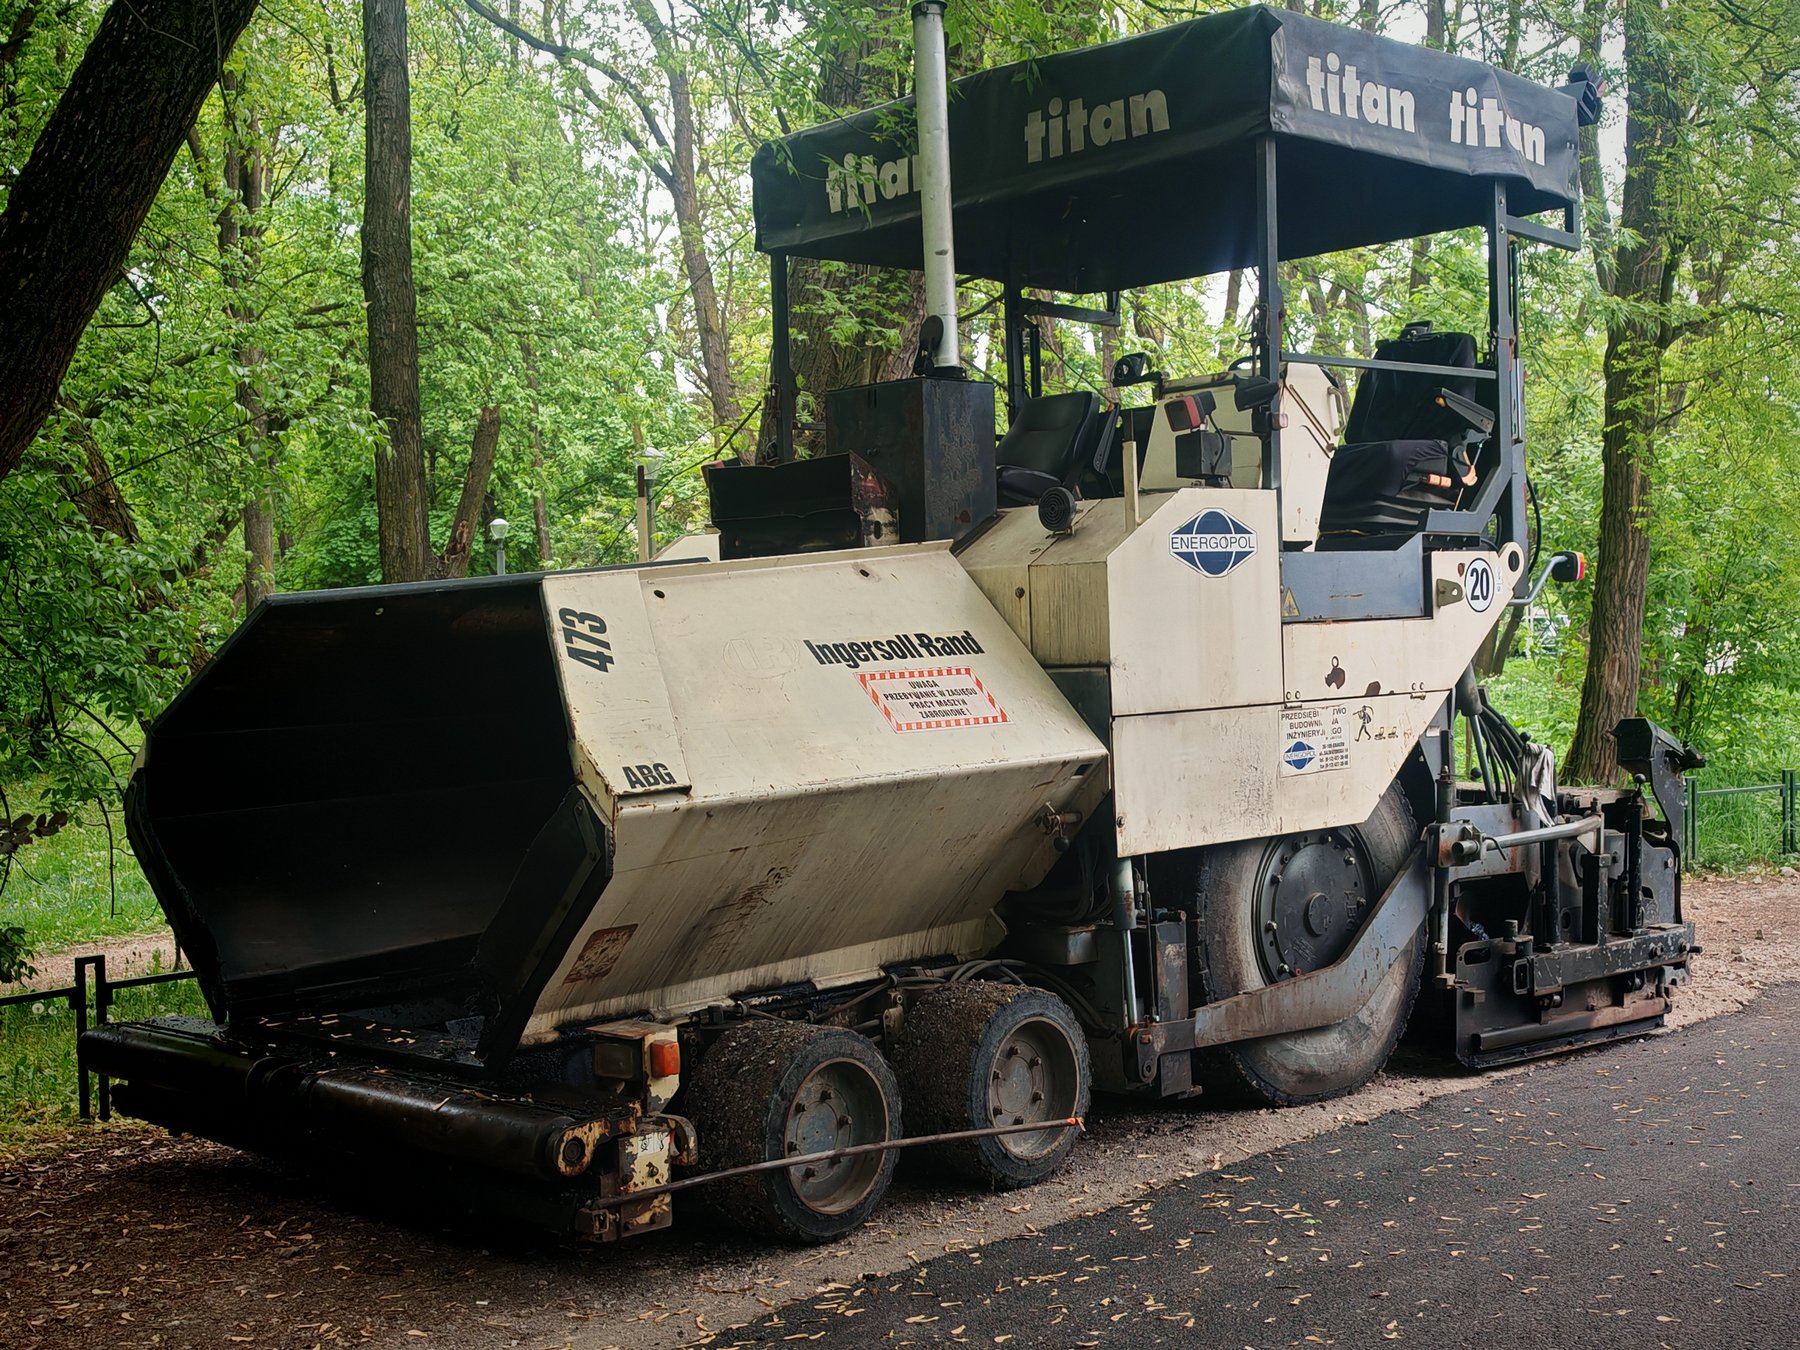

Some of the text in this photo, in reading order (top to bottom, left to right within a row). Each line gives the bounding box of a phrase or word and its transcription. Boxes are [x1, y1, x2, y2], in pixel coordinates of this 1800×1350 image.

[1306, 52, 1416, 134] titan
[1024, 89, 1171, 164] titan
[1449, 87, 1546, 167] titan
[825, 152, 923, 214] tita
[1171, 536, 1255, 550] ENERGOPOL
[1470, 567, 1490, 601] 20
[558, 607, 615, 673] 473
[883, 687, 978, 701] PRZEBYWANIE W ZASIĘGU
[908, 679, 940, 690] UWAGA
[908, 699, 968, 710] PRACY MASZYN
[918, 708, 967, 719] ZABRONIONE
[622, 762, 677, 789] ABG
